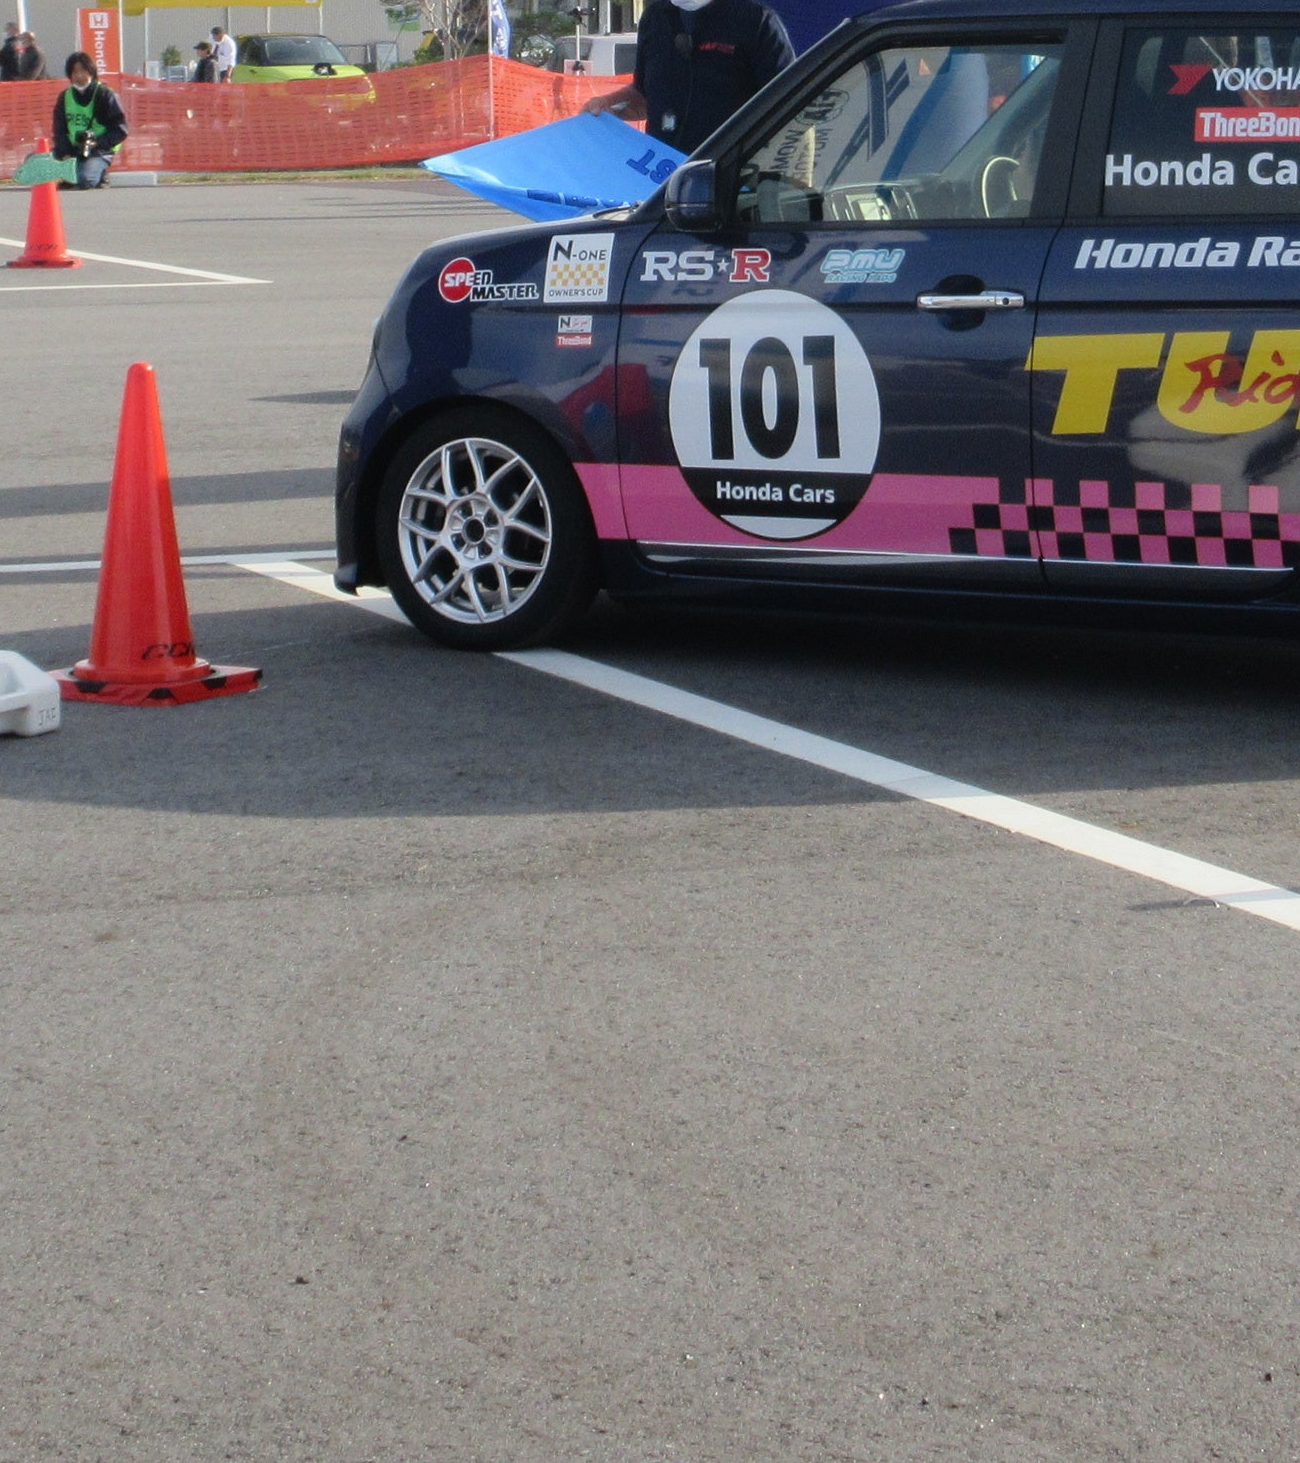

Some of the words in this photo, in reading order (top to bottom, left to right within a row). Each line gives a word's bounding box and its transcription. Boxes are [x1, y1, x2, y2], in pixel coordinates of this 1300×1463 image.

[1104, 153, 1234, 186] Honda
[553, 240, 607, 261] N-ONE
[1074, 237, 1240, 269] Honda
[444, 271, 492, 287] SPEED
[549, 288, 584, 297] OWNER'S
[586, 288, 604, 296] CUP
[557, 336, 592, 346] ThreeBond
[699, 335, 841, 461] 101
[716, 480, 783, 502] Honda
[788, 482, 835, 504] Cars
